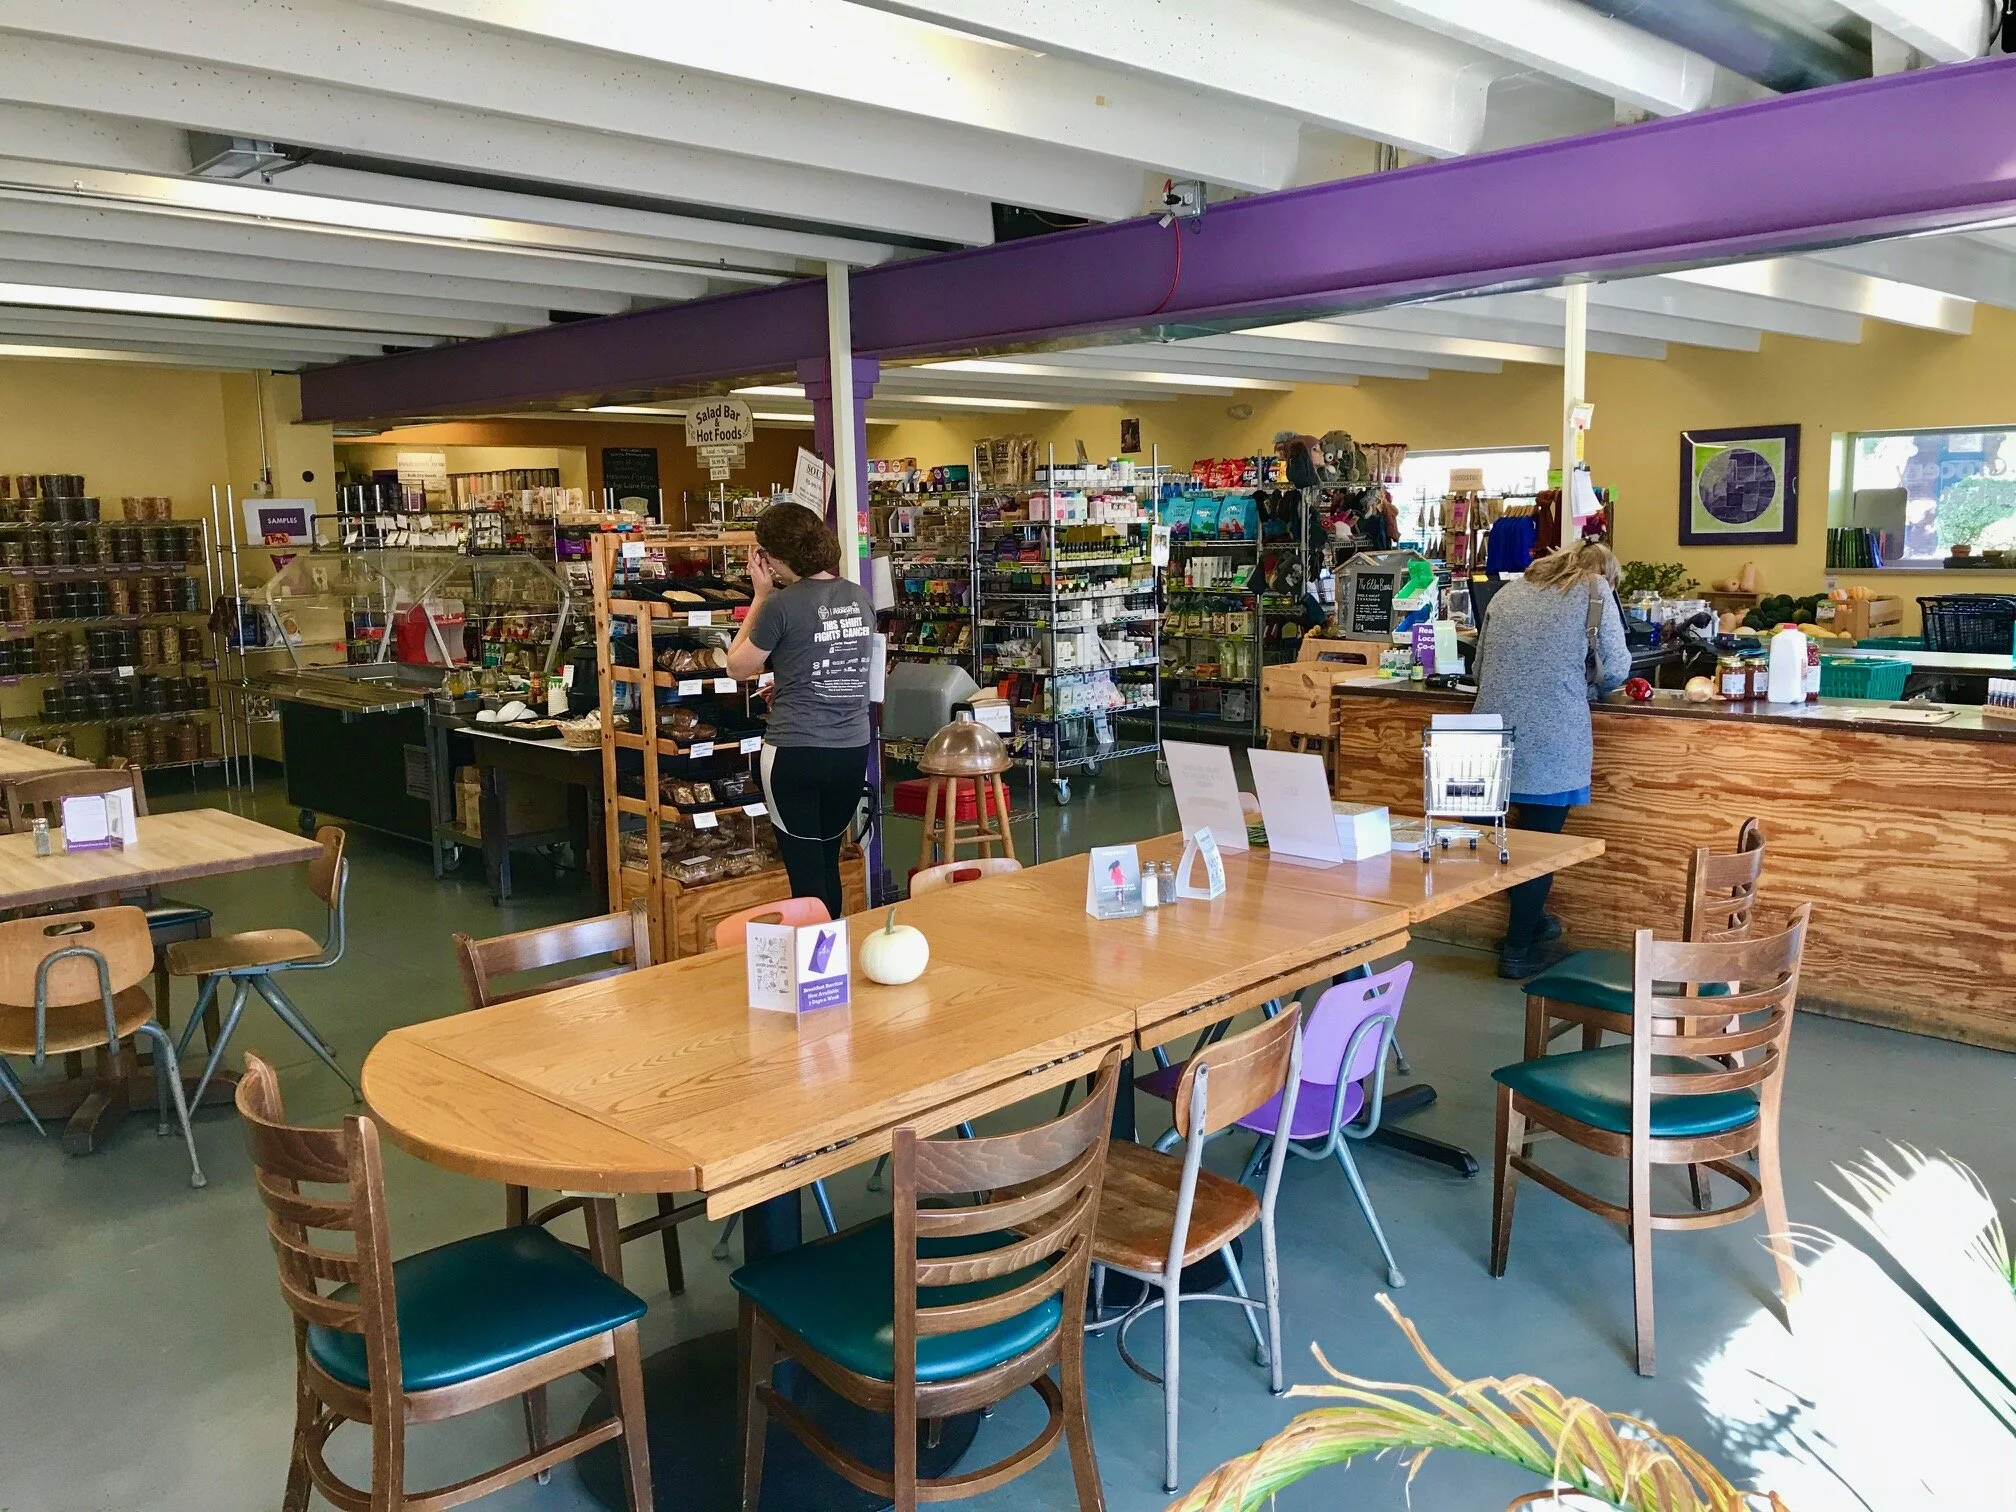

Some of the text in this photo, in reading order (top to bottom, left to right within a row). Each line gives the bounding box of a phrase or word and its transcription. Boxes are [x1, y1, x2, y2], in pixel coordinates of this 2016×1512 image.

[696, 404, 741, 426] Salad Bar
[714, 417, 720, 427] &
[696, 426, 742, 442] Hot Foods
[267, 517, 298, 525] SAMPLES
[822, 616, 863, 631] THIS SHIRT
[814, 630, 841, 643] FIGHTS
[803, 984, 825, 993] Breakfast
[807, 992, 818, 1000] Now
